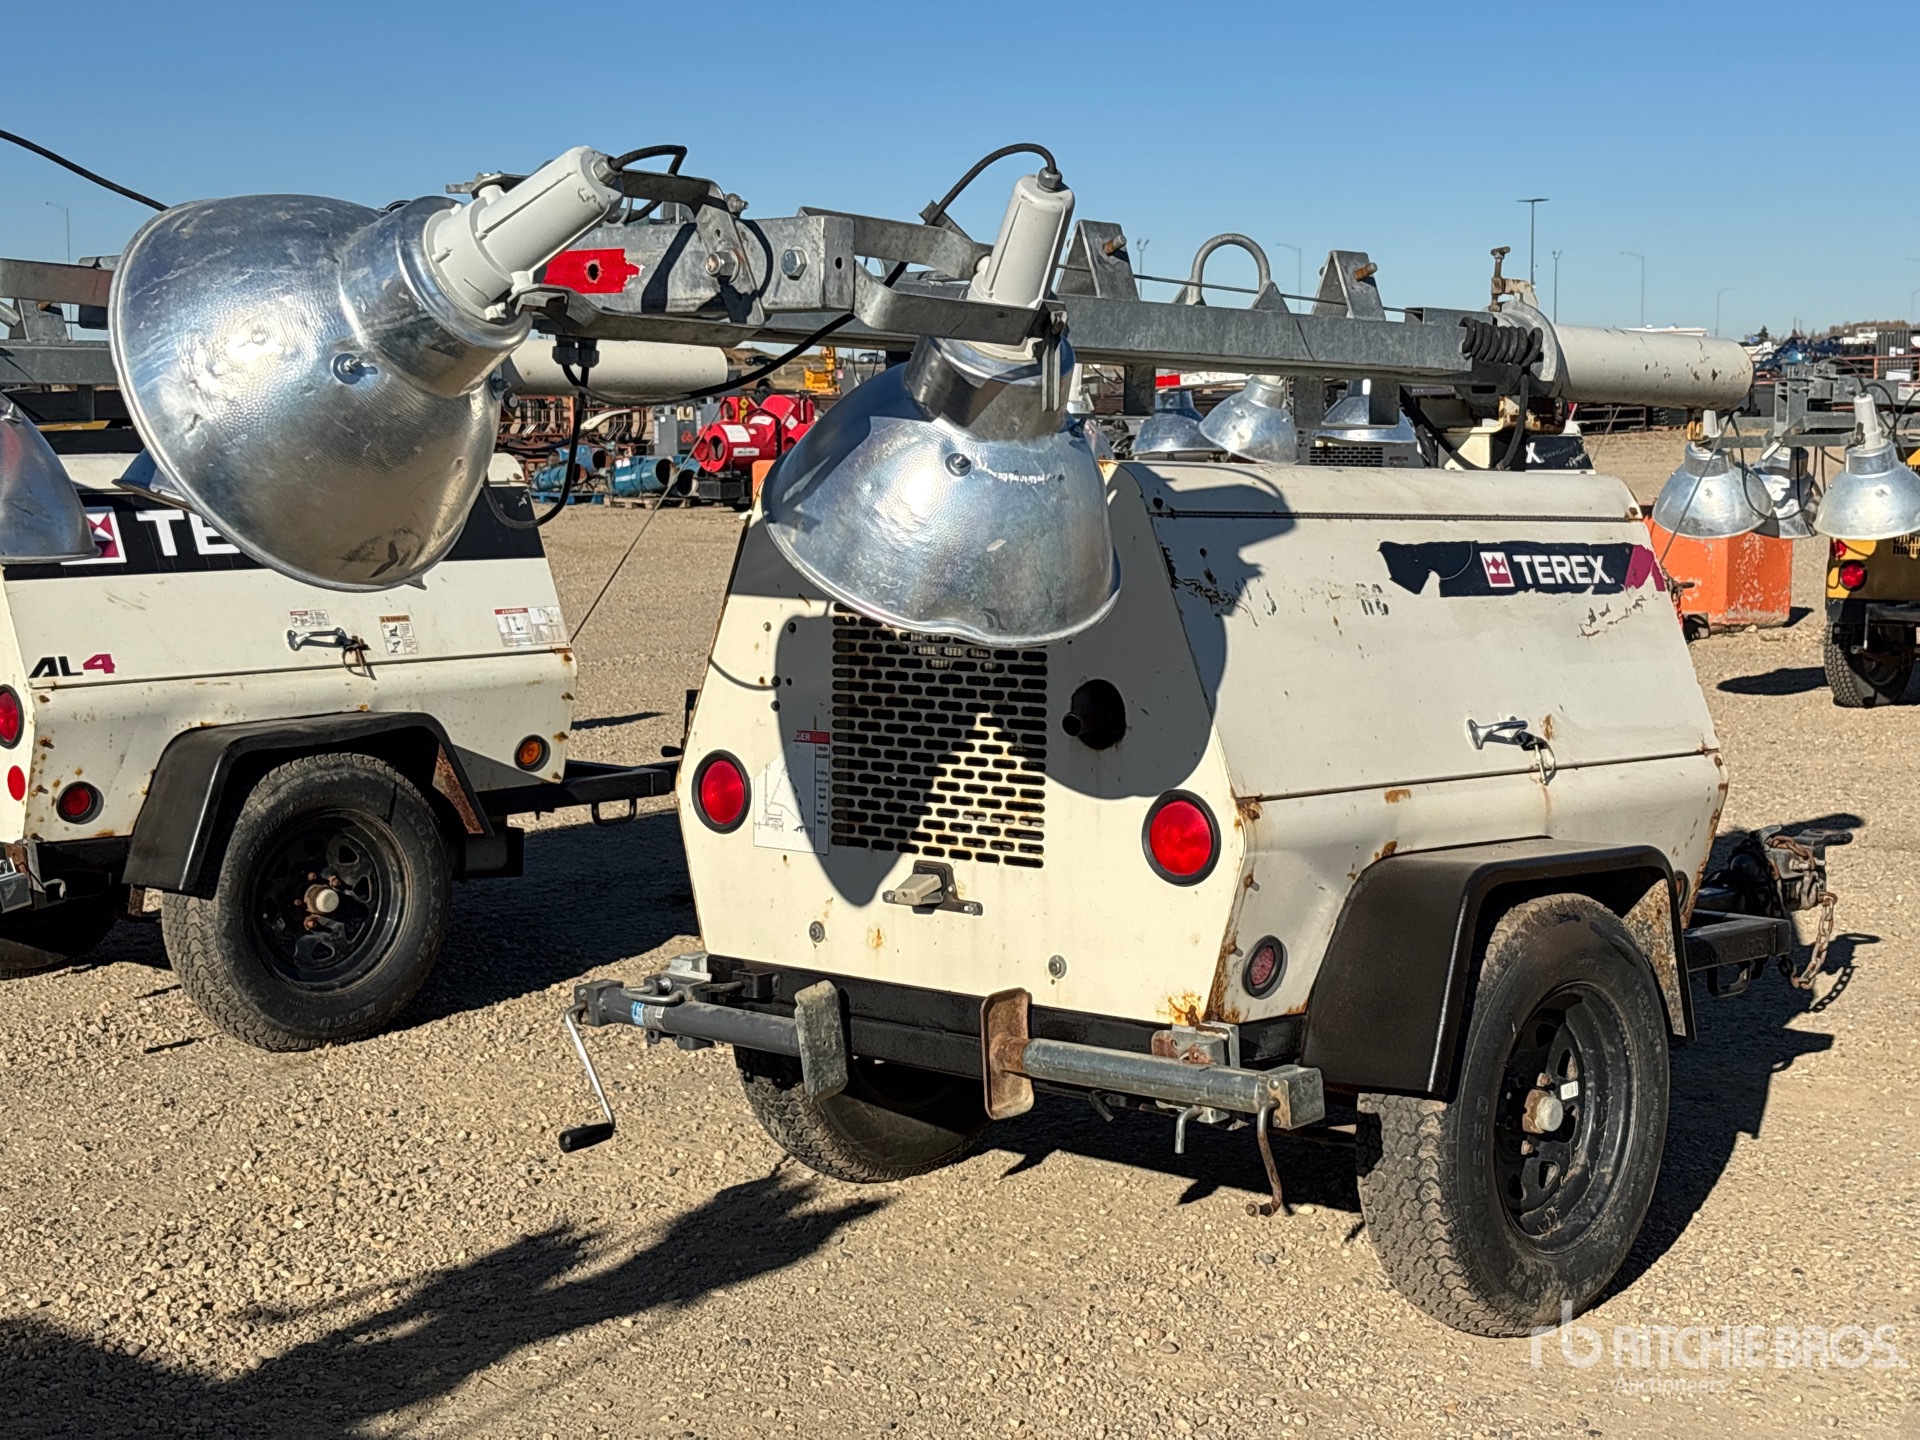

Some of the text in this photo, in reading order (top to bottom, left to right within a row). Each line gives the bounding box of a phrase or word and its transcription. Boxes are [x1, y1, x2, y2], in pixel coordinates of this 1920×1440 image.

[135, 509, 241, 556] TE
[1512, 554, 1609, 585] TEREX
[28, 653, 116, 678] AL4
[795, 732, 811, 741] GER
